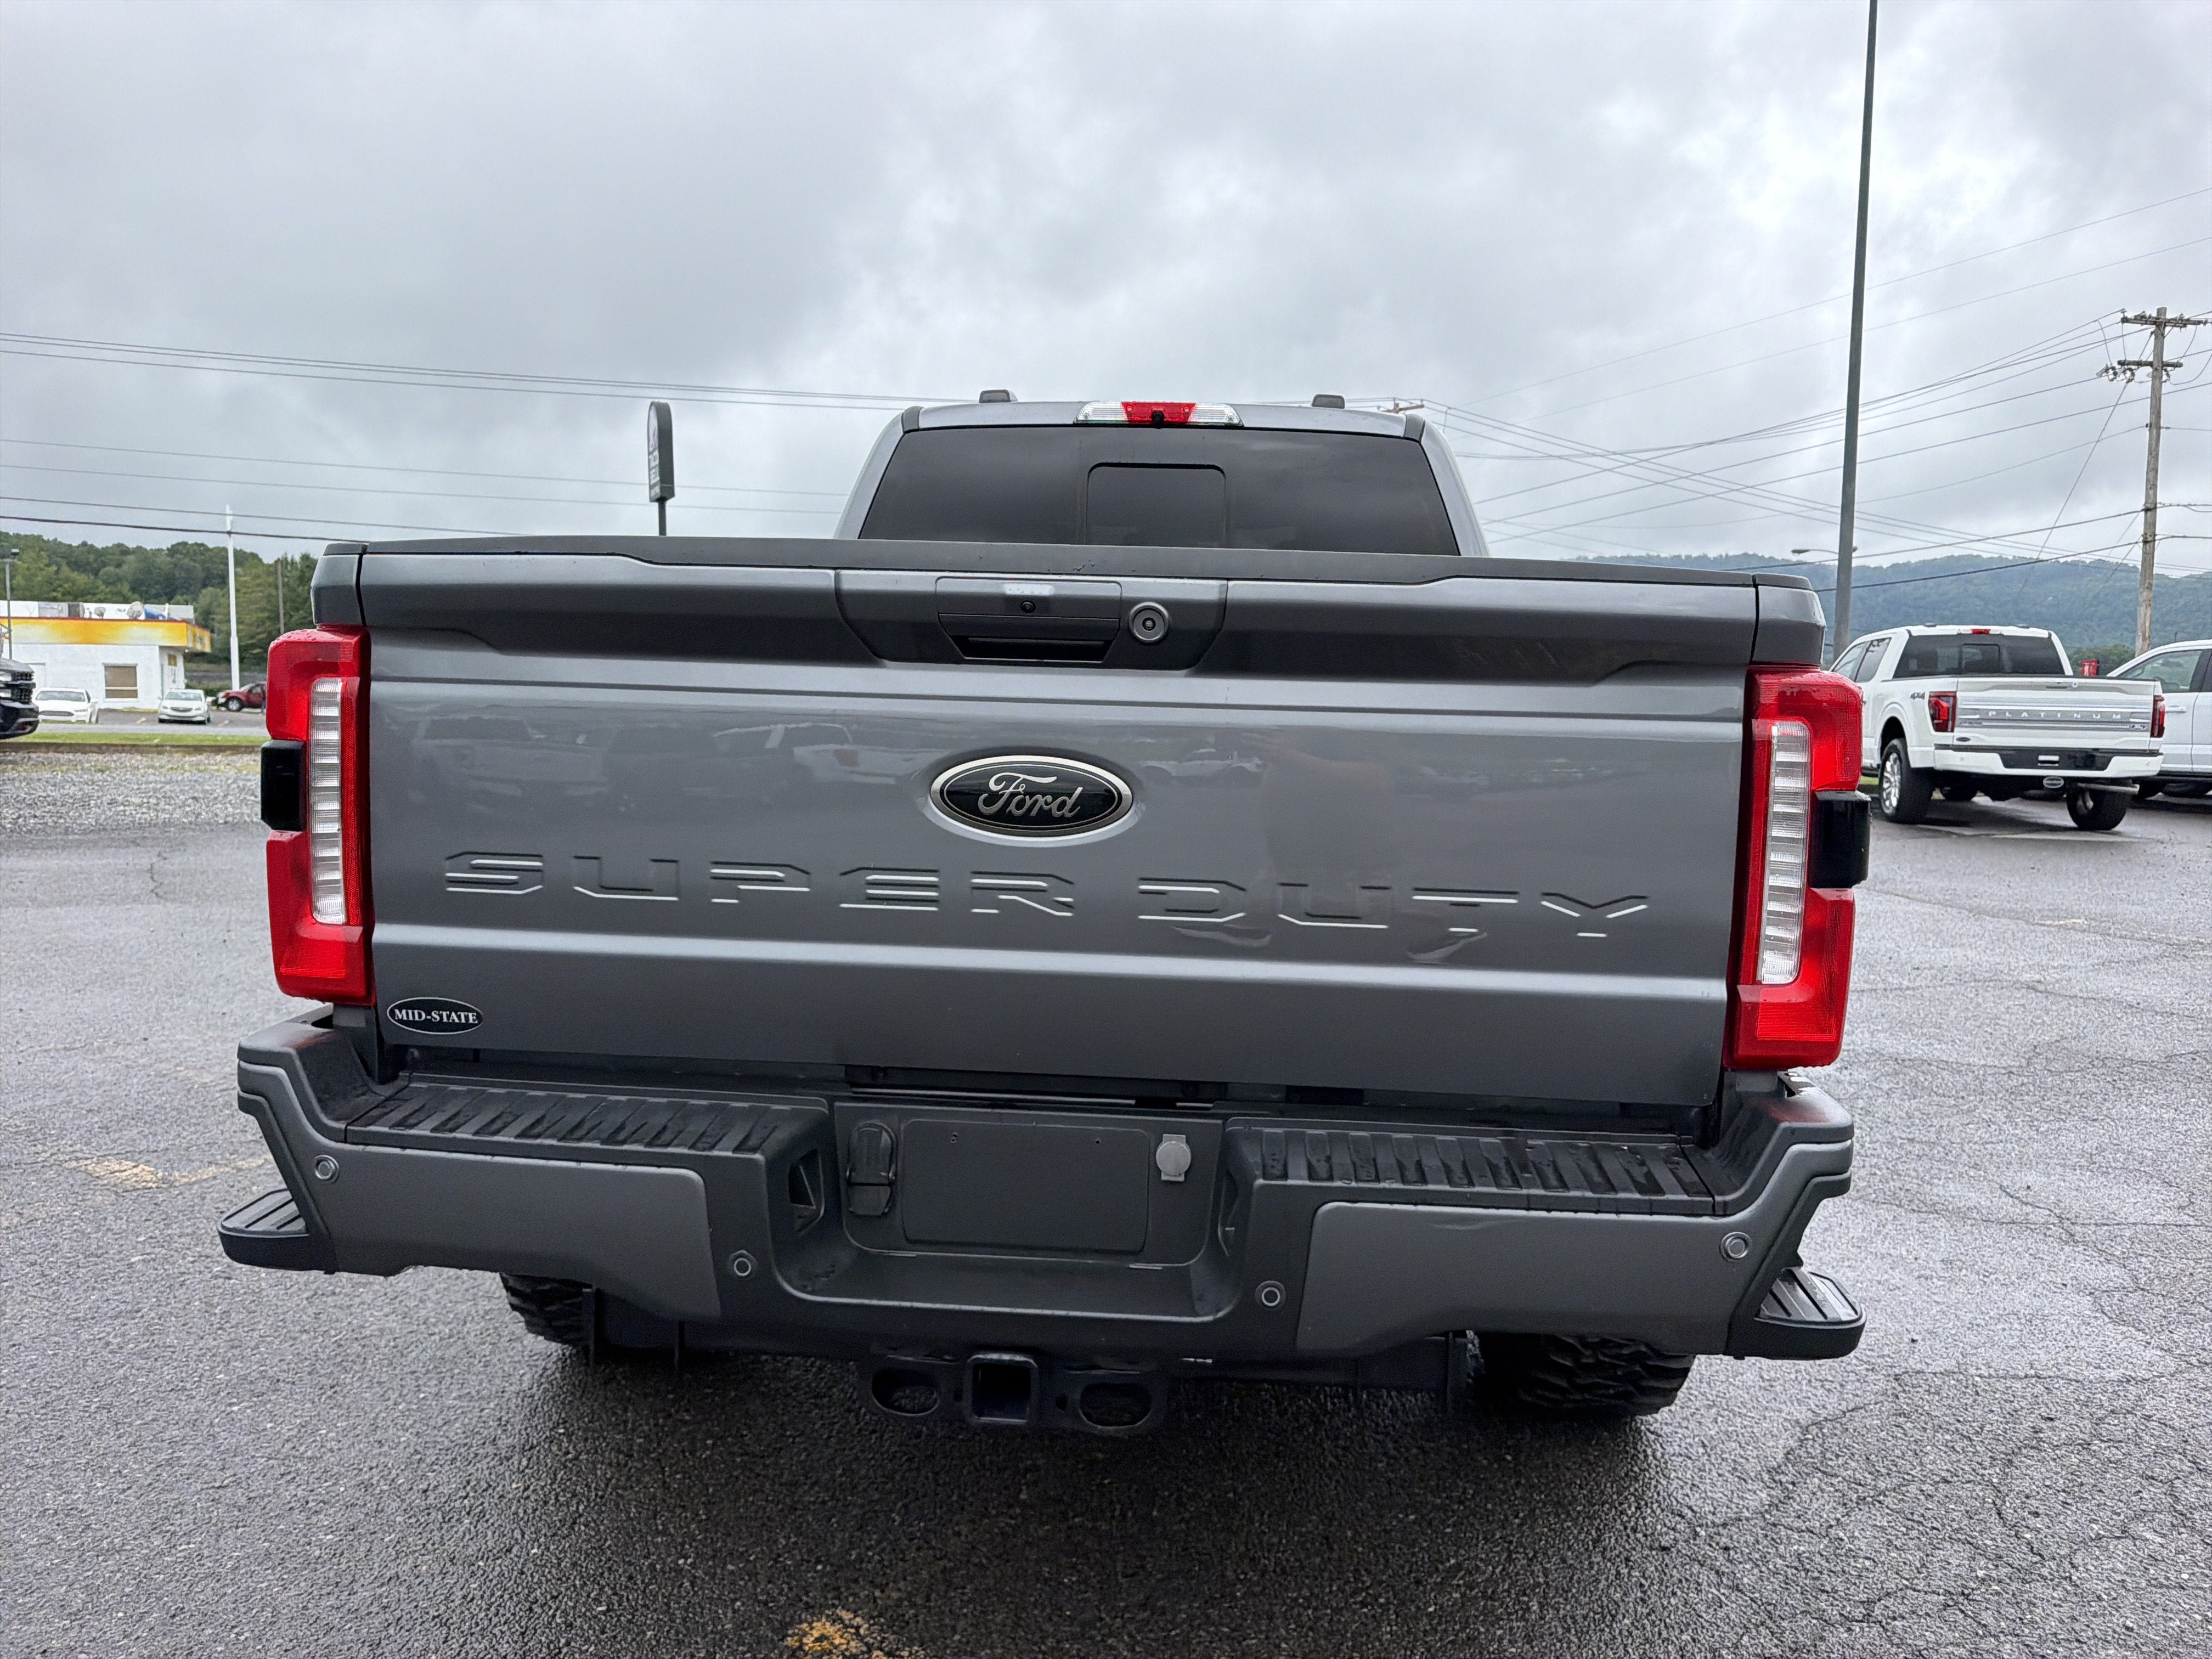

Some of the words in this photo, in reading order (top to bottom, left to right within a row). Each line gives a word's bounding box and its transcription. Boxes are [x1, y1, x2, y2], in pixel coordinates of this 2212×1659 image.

[1988, 710, 2121, 720] PLATINUM
[977, 771, 1084, 819] Ford
[445, 851, 1075, 917] SUPER
[1137, 877, 1649, 938] DUTY
[393, 1008, 478, 1024] MID-STATE
